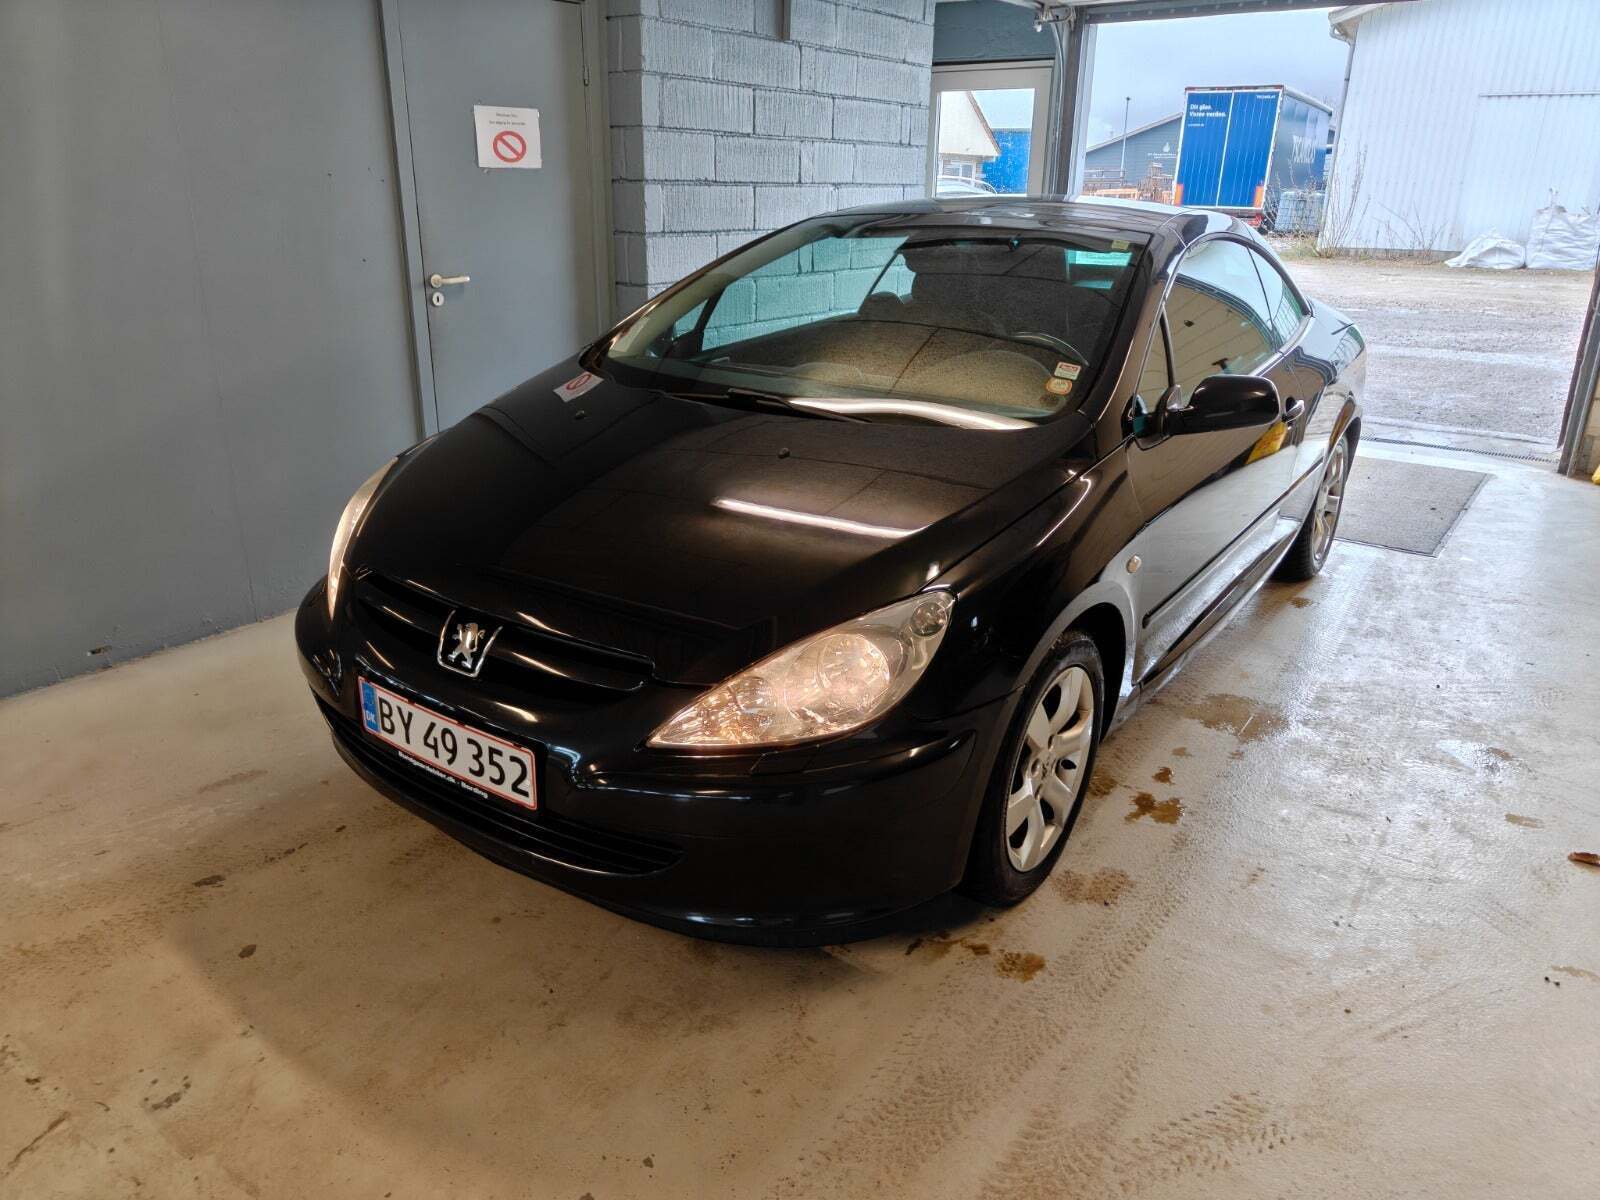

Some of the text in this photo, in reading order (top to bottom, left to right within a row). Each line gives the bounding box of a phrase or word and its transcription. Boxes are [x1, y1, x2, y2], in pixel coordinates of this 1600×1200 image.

[366, 710, 377, 724] DK
[378, 697, 530, 798] BY 49 352
